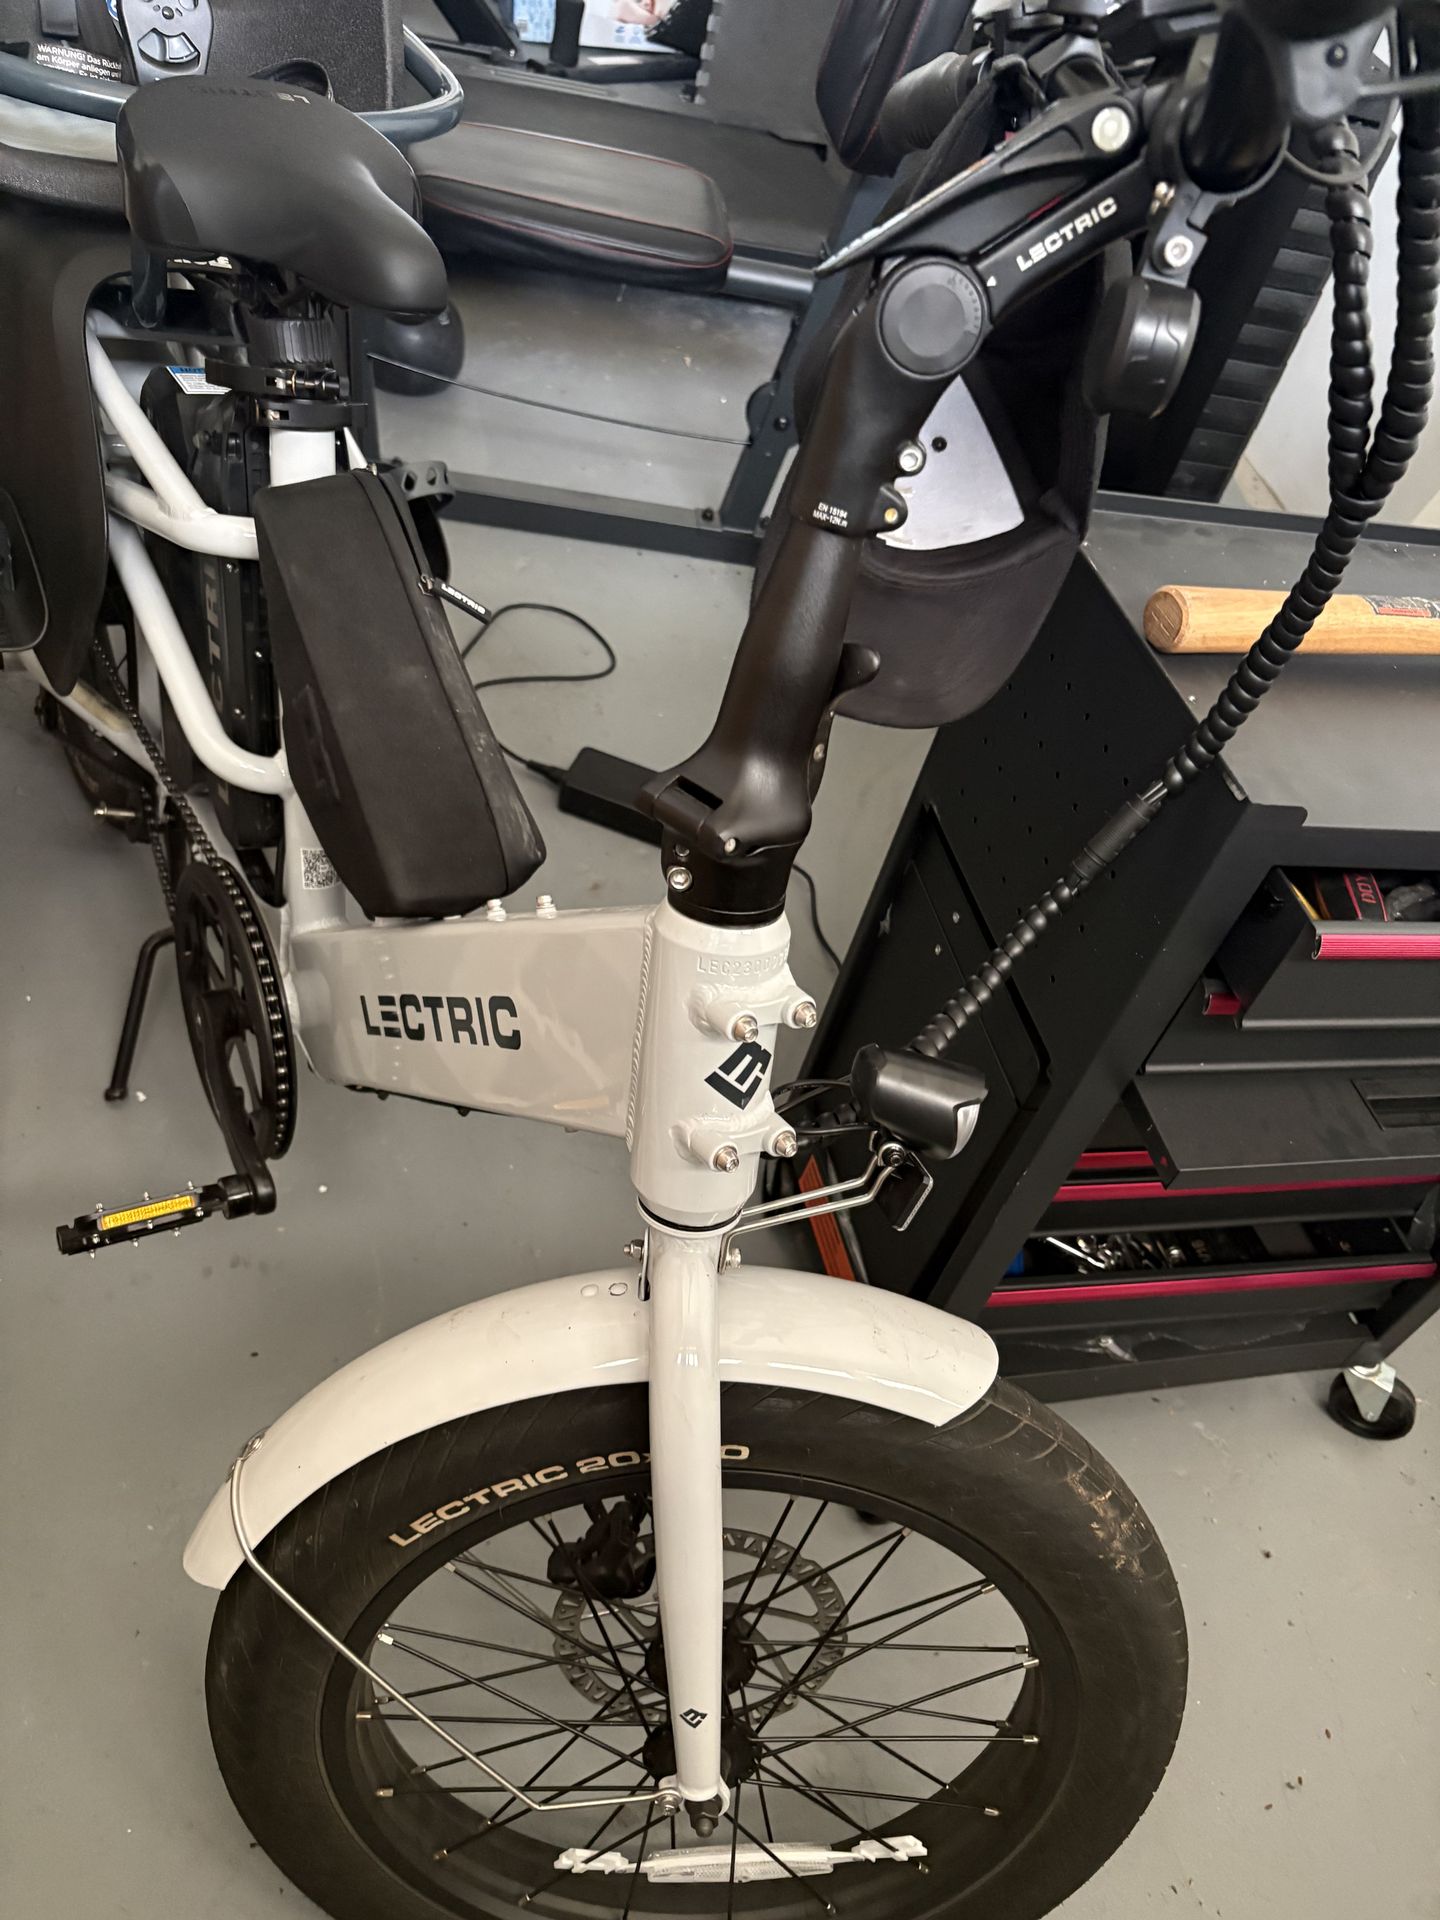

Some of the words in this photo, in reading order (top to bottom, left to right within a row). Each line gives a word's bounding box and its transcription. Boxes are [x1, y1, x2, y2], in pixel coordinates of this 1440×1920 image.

[36, 54, 50, 62] am
[51, 55, 80, 69] Körper
[81, 63, 111, 76] anliegen
[37, 45, 86, 62] WARNUNG!
[86, 55, 101, 65] Das
[1016, 197, 1117, 272] LECTRIC
[818, 502, 829, 512] EN
[441, 583, 486, 615] LECTRIC
[360, 994, 522, 1051] LECTRIC
[388, 1464, 568, 1547] LECTRIC
